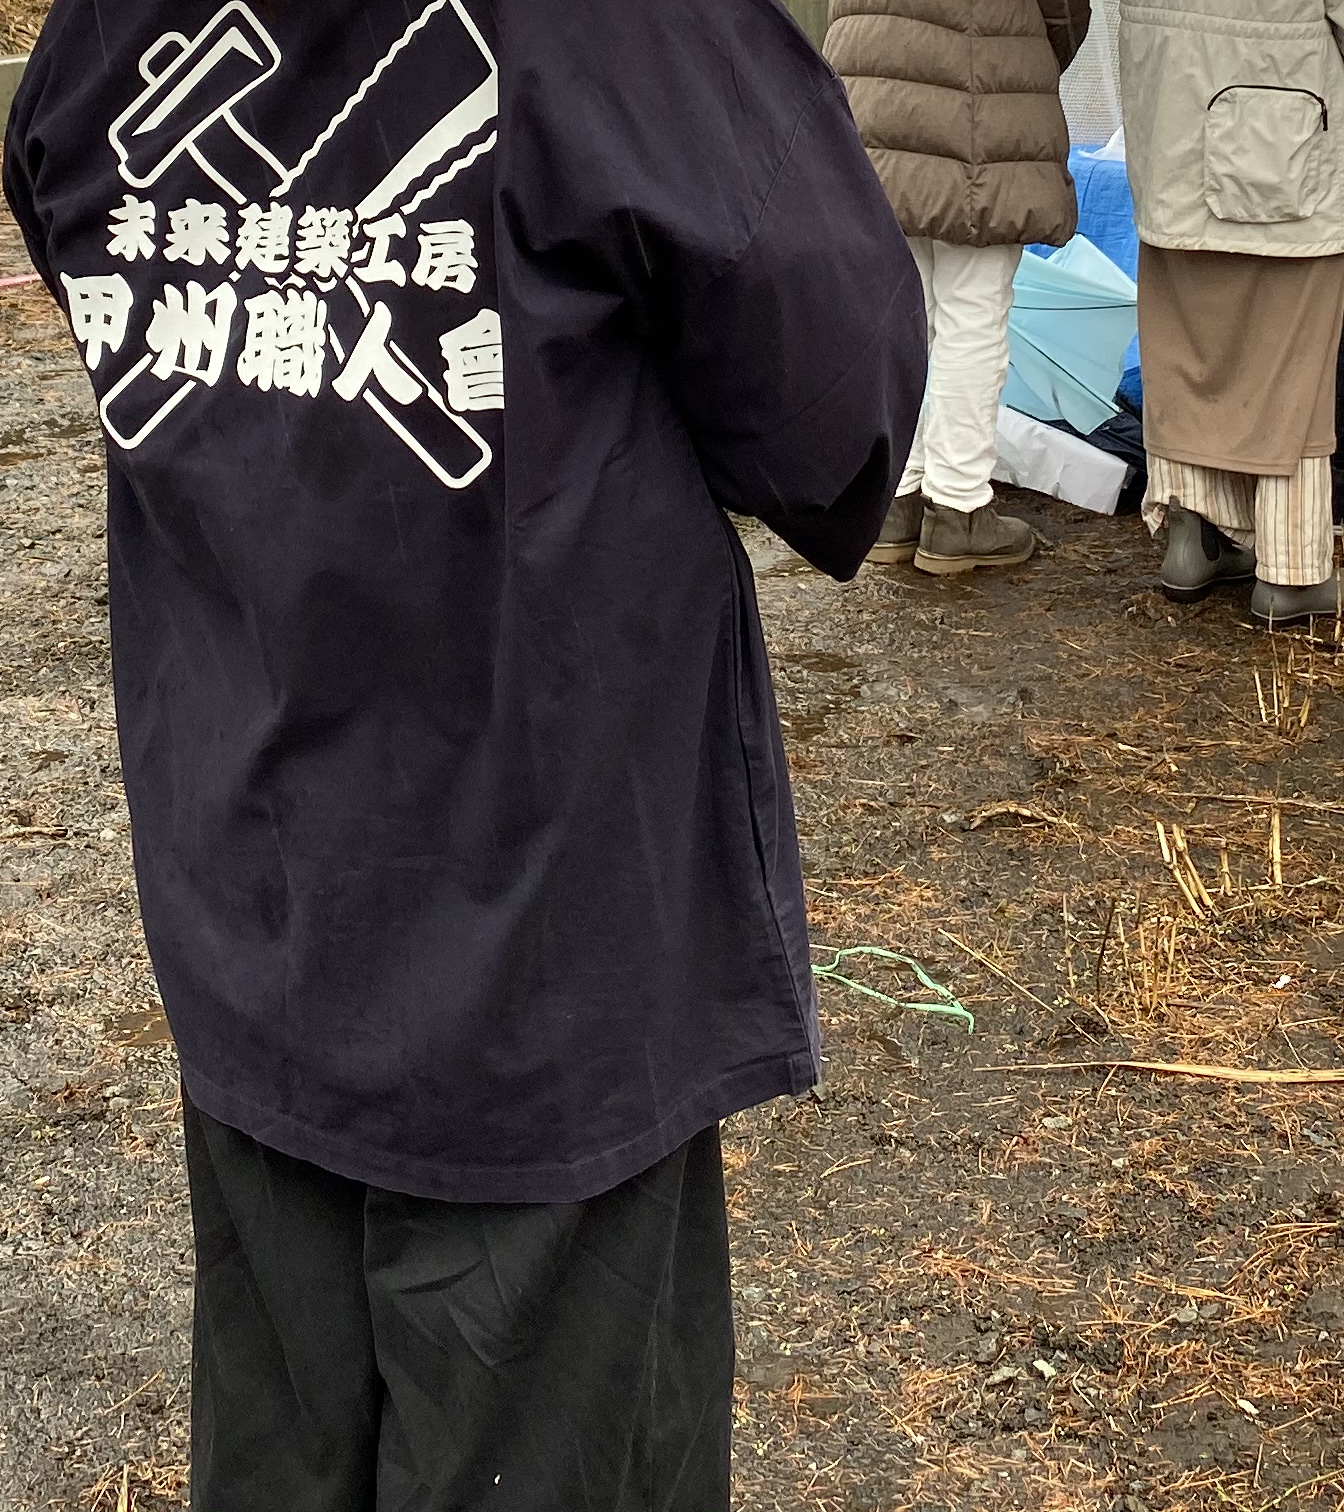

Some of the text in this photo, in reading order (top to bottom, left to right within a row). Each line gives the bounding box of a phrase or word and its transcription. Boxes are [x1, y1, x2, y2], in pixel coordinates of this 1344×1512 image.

[106, 194, 479, 293] 未来建築工房
[60, 271, 505, 412] 甲州職人會
